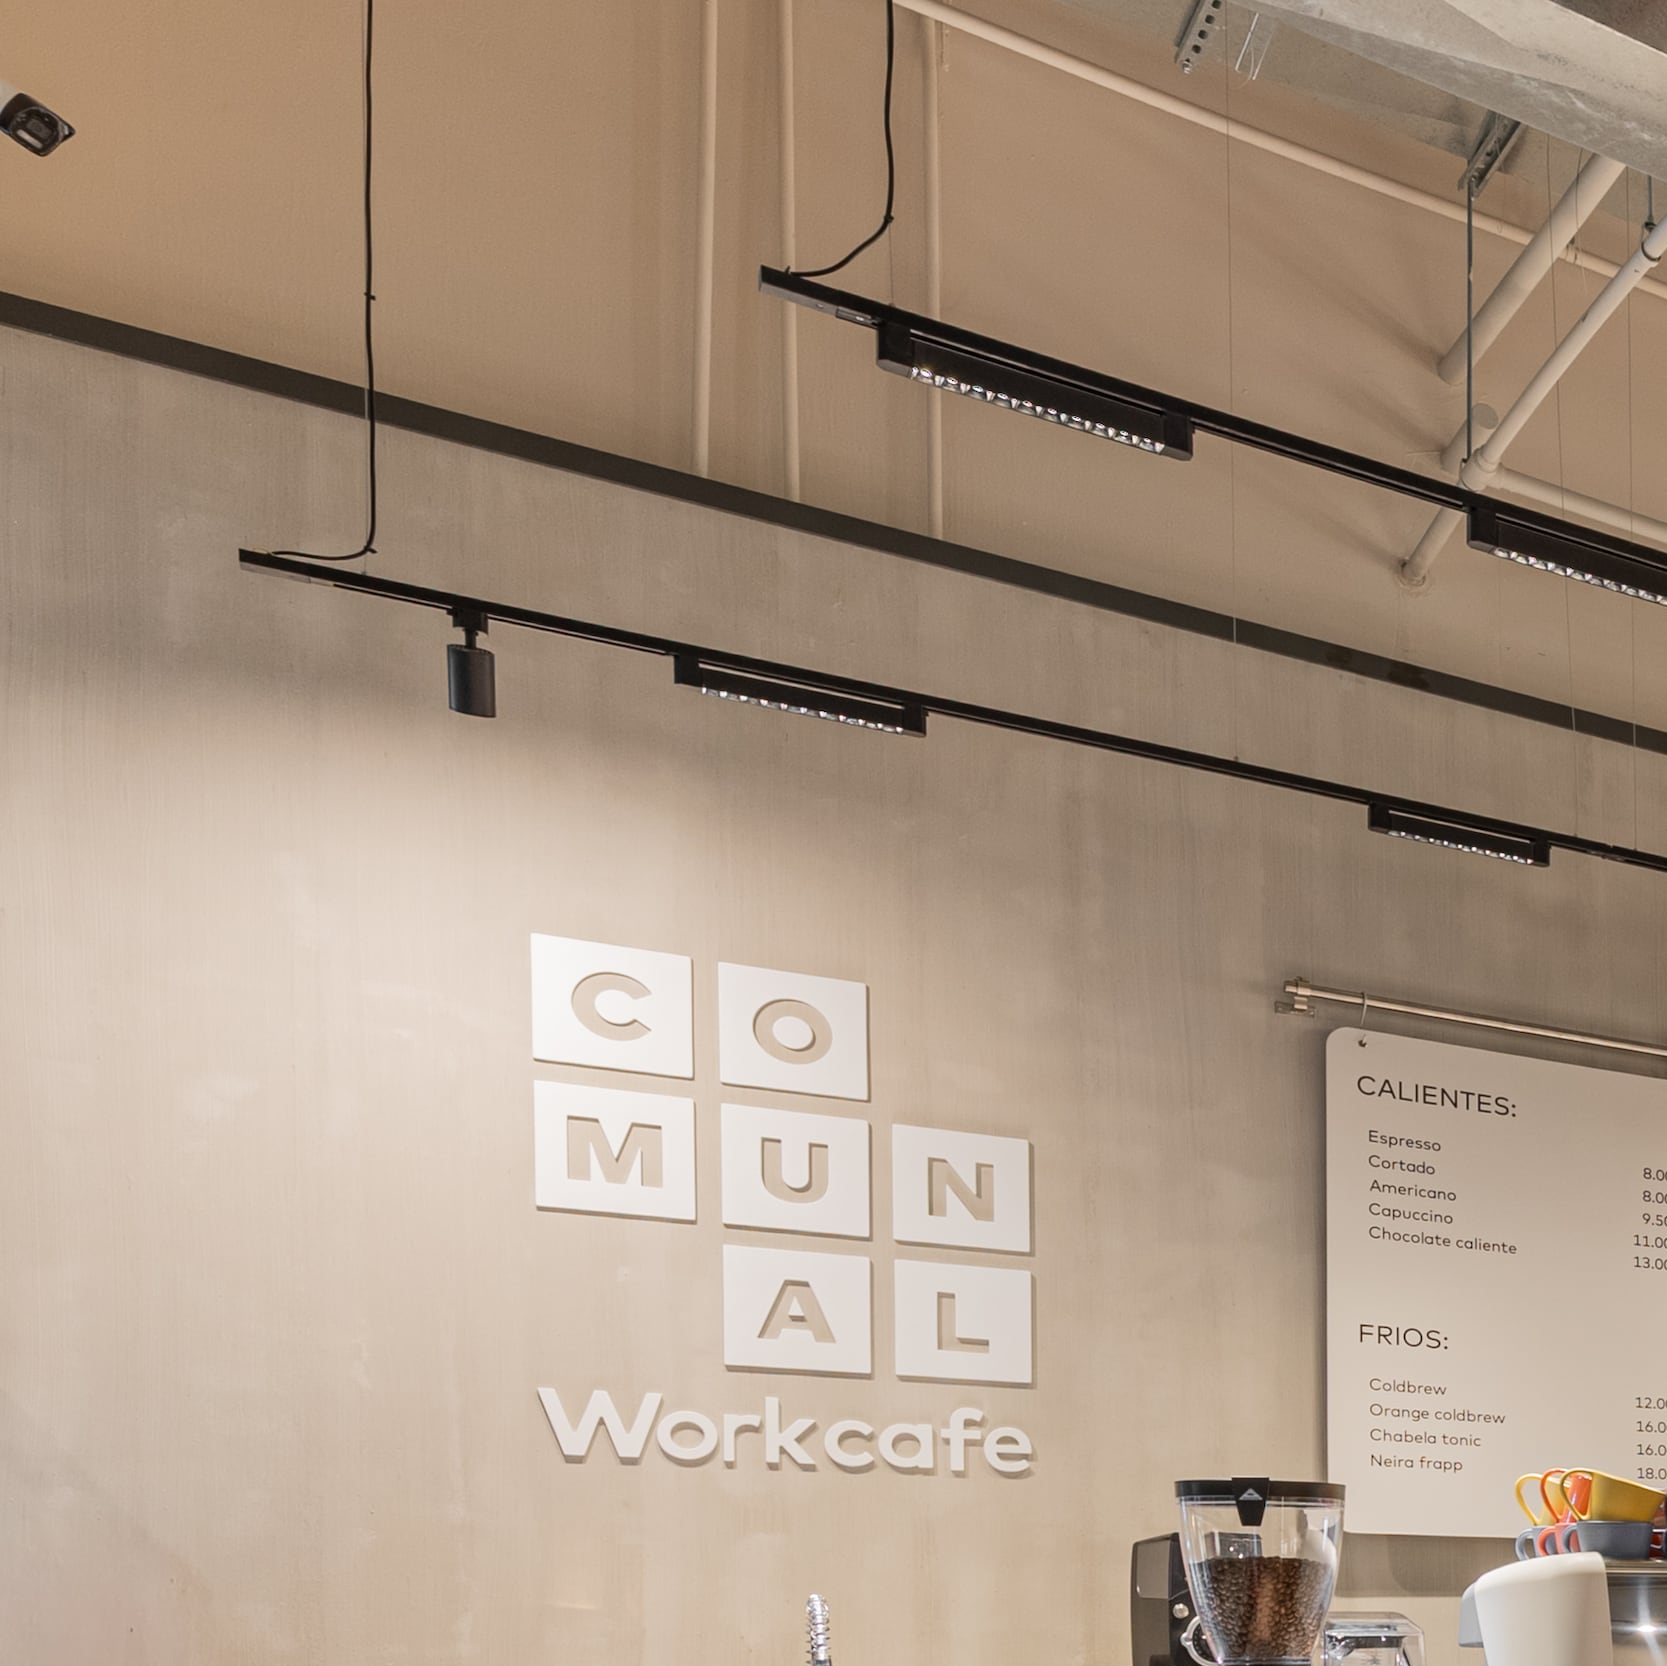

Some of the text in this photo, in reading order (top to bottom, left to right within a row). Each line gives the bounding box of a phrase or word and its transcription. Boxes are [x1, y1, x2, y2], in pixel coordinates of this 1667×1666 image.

[1357, 1076, 1516, 1117] CALIENTES:
[1369, 1129, 1441, 1151] Espresso
[1368, 1155, 1435, 1175] Cortado
[1370, 1179, 1456, 1201] Americano
[1369, 1203, 1453, 1224] Capuccino
[1369, 1226, 1451, 1247] Chocolate
[1456, 1238, 1517, 1254] caliente
[1360, 1324, 1448, 1349] FRIOS:
[1369, 1378, 1446, 1395] Coldbrew
[1370, 1403, 1429, 1422] Orange
[1435, 1408, 1505, 1423] coldbrew
[537, 1386, 1034, 1473] Workcafe
[1370, 1428, 1436, 1444] Chabela
[1441, 1434, 1481, 1447] tonic
[1371, 1454, 1414, 1468] Neira
[1419, 1456, 1463, 1473] frapp
